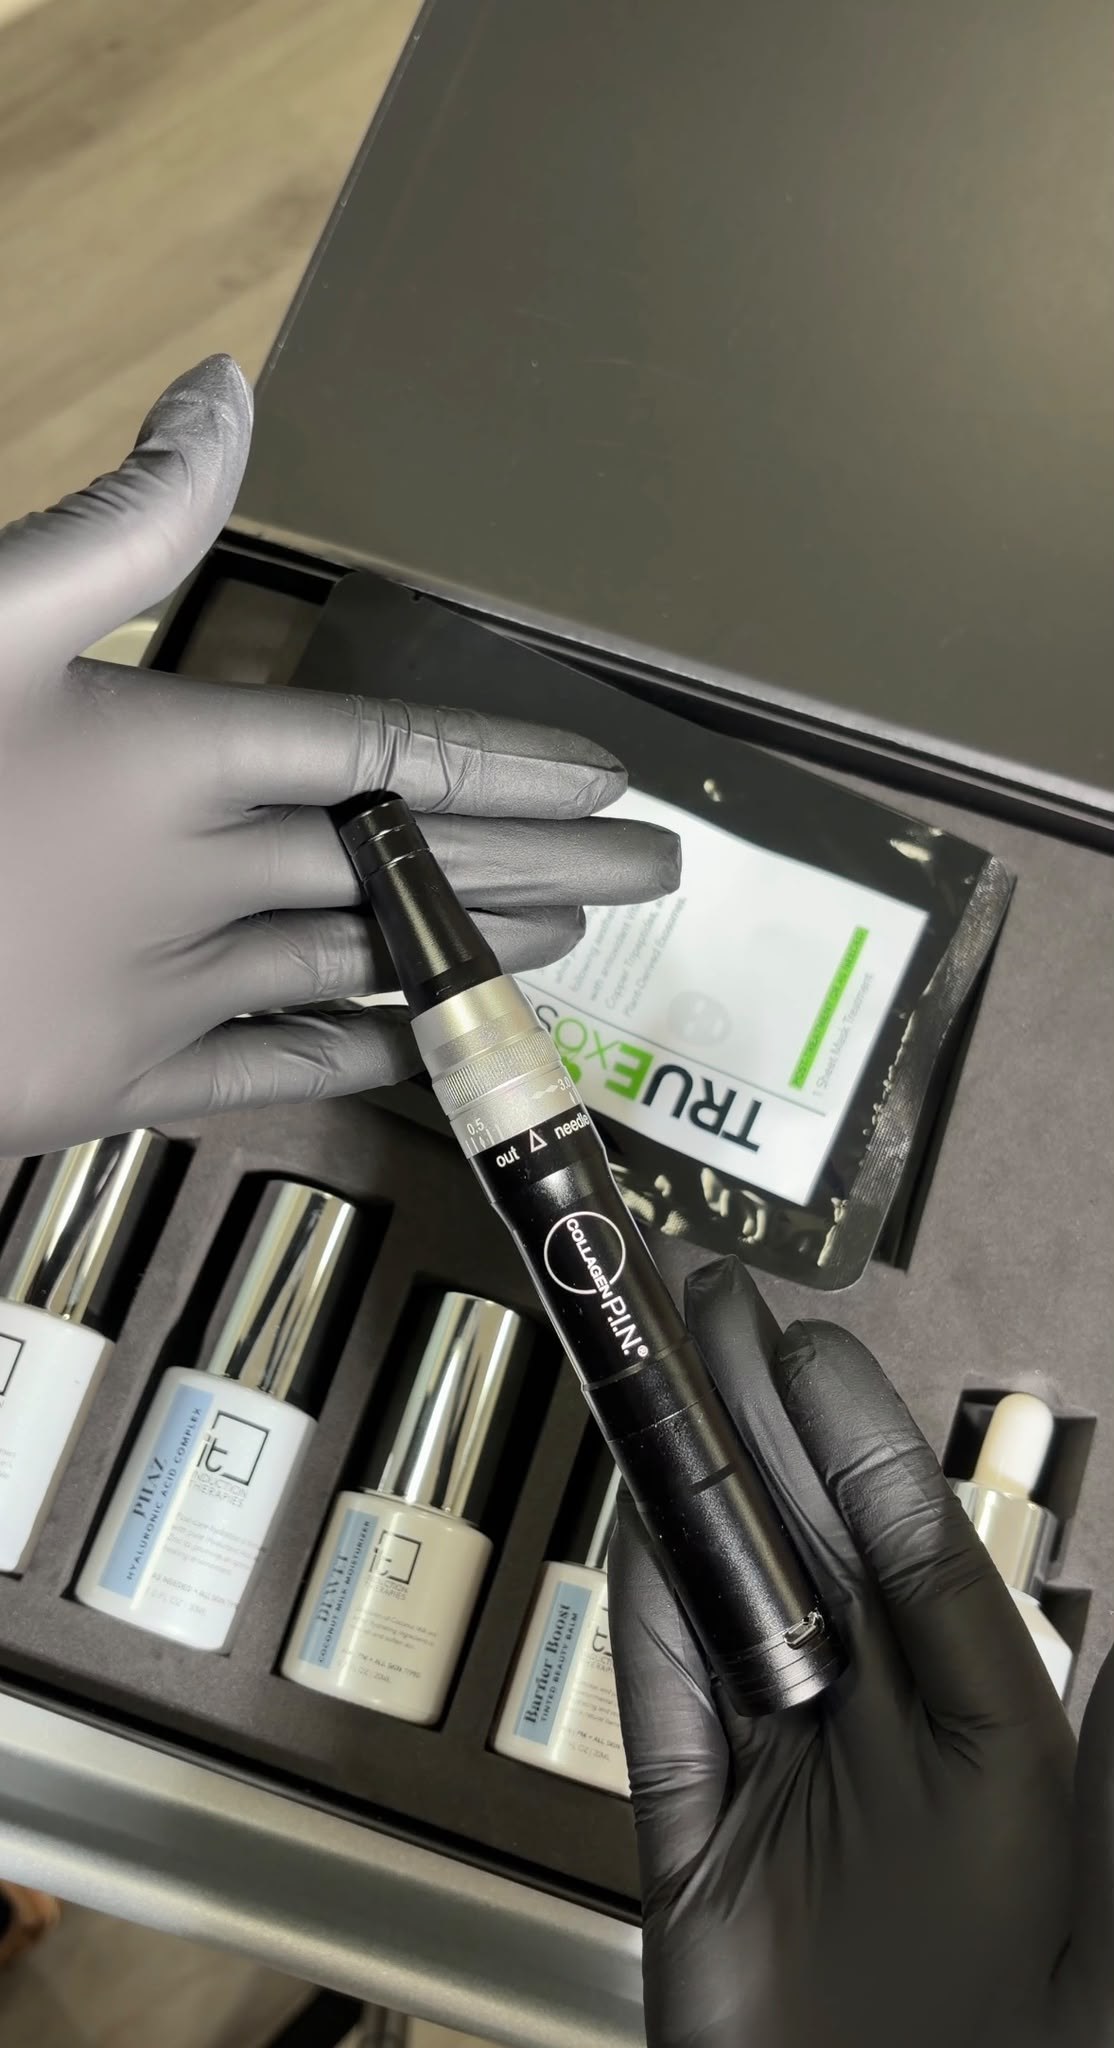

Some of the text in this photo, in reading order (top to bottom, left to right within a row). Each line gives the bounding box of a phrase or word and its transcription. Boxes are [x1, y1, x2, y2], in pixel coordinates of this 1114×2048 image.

[466, 1117, 485, 1136] 0.5
[496, 1112, 590, 1168] out needle
[566, 1218, 614, 1300] COLLAGEN
[125, 1407, 201, 1580] HYALURONIC ACID COMPLEX
[317, 1614, 338, 1663] COCONUT
[334, 1588, 347, 1612] MILK
[344, 1520, 370, 1585] MOISTURIZER
[523, 1603, 570, 1724] Barrier Boost
[540, 1612, 578, 1721] TINTED BEAUTY BALM
